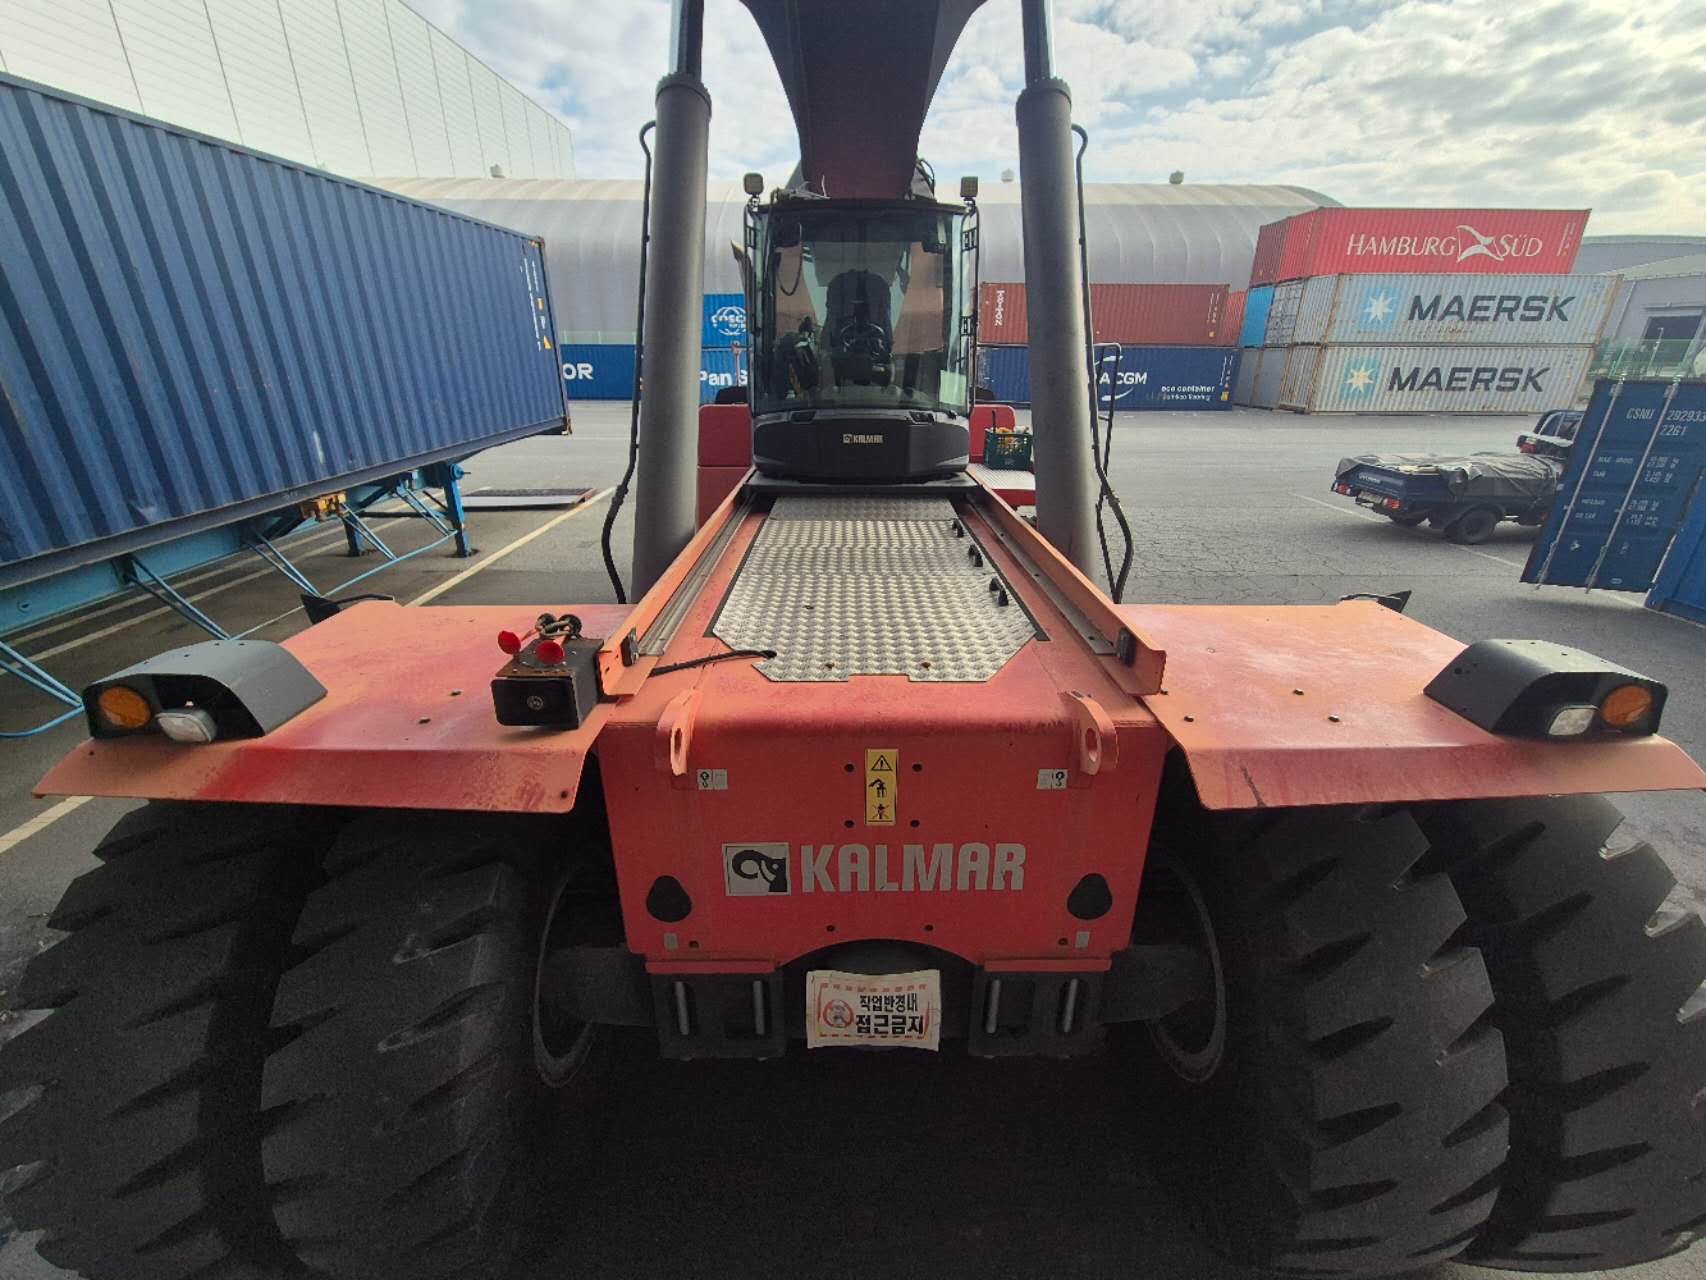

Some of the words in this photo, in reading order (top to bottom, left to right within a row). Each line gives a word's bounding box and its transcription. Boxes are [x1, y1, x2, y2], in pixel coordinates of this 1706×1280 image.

[1346, 233, 1456, 257] HAMBURG
[1500, 232, 1543, 257] SÜD
[1407, 295, 1576, 322] MAERSK
[1116, 372, 1147, 385] CGM
[1387, 367, 1551, 392] MAERSK
[801, 842, 1026, 892] KALMAR
[855, 1014, 925, 1034] 접근금지
